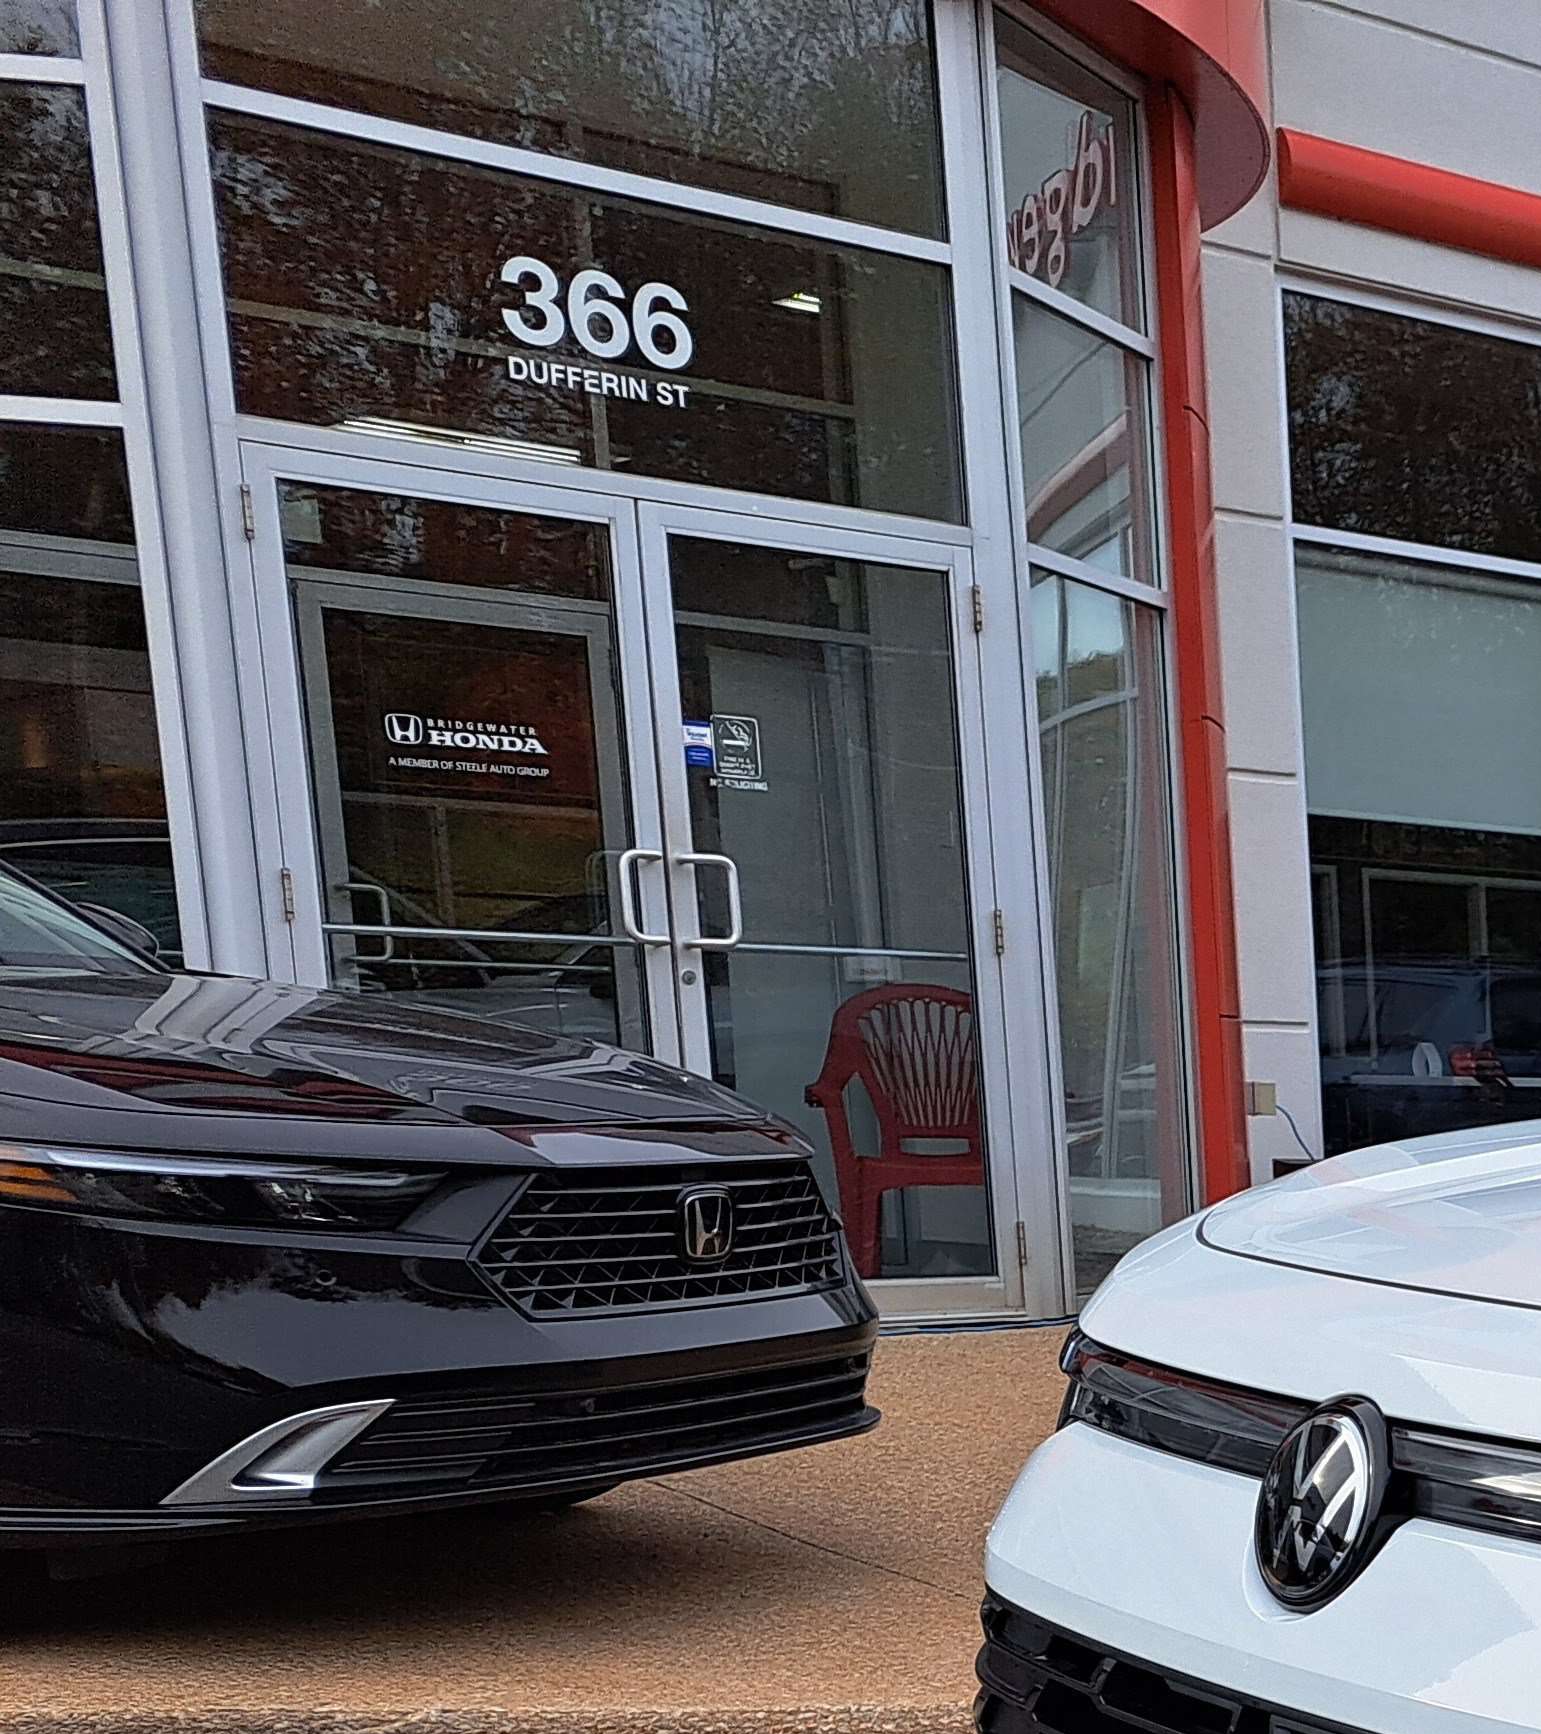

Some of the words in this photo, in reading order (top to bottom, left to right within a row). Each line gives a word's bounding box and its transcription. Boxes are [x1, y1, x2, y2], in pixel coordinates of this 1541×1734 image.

[500, 255, 694, 370] 366
[507, 355, 650, 402] DUFFERIN
[656, 381, 691, 409] ST
[427, 718, 537, 736] BRIDGEWATER
[427, 729, 550, 755] HONDA
[388, 756, 397, 766] A
[398, 757, 440, 769] MEMBER
[440, 760, 453, 770] OF
[489, 764, 516, 775] AUTO
[516, 766, 550, 777] GROUP
